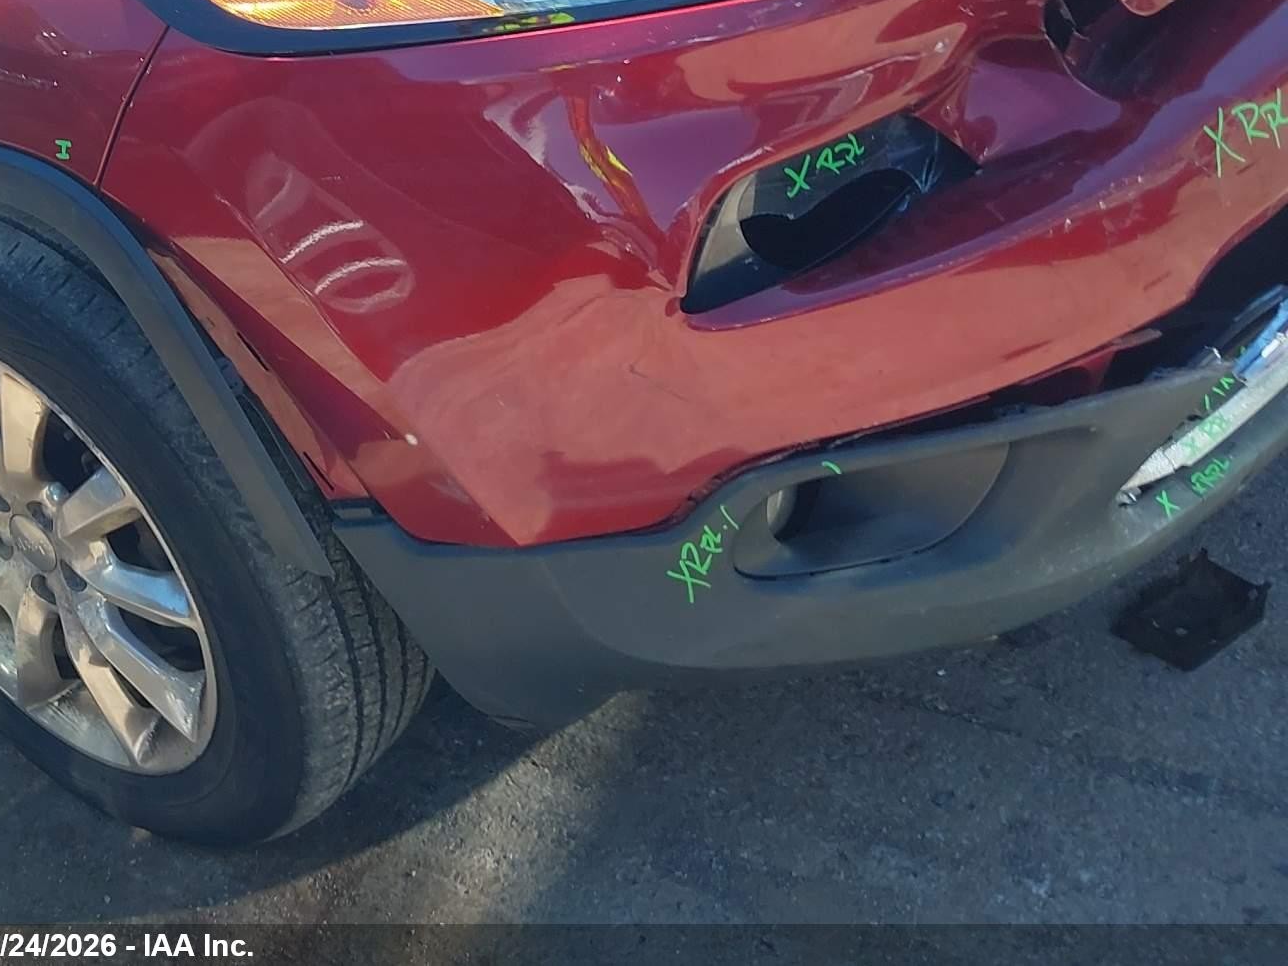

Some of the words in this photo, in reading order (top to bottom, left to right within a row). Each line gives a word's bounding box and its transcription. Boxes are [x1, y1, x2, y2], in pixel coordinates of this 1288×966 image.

[1203, 106, 1246, 178] X
[784, 154, 811, 199] X
[1155, 490, 1181, 520] X
